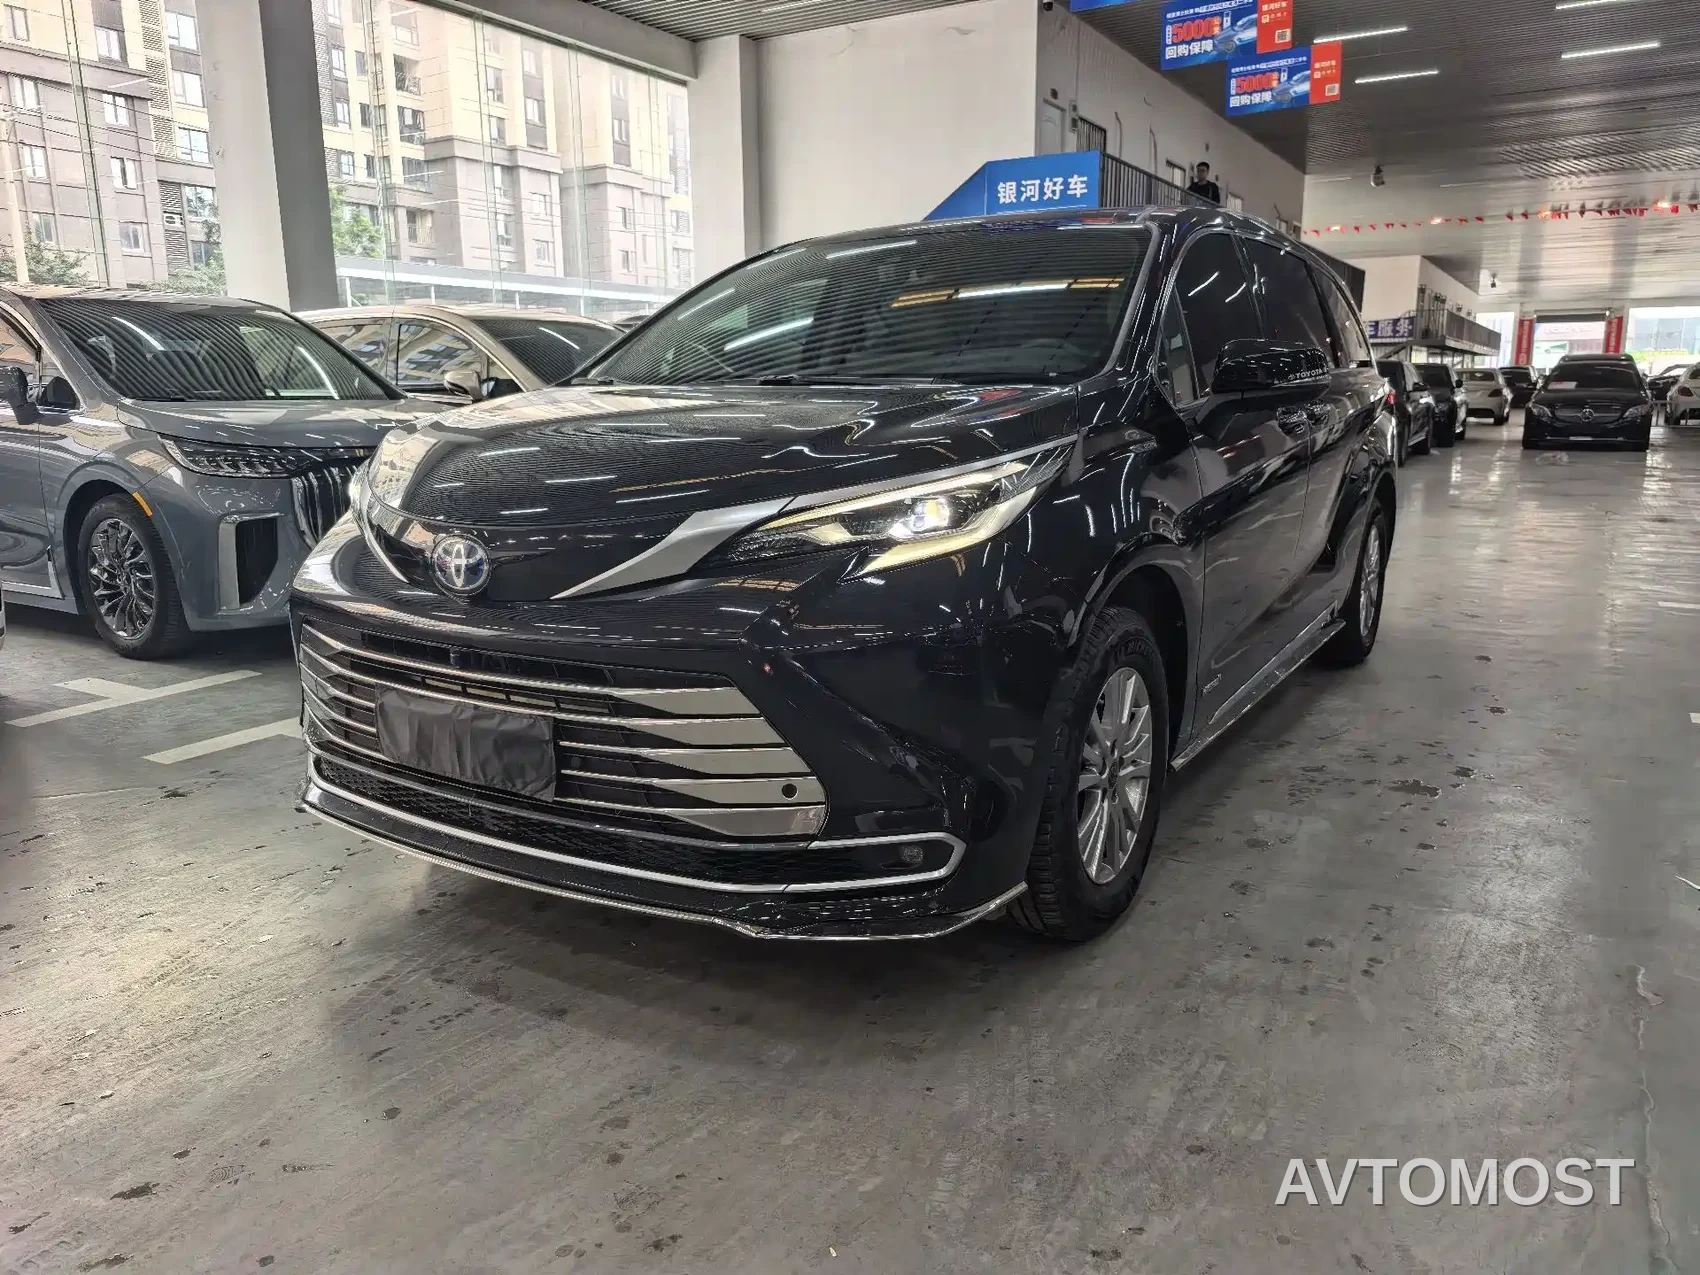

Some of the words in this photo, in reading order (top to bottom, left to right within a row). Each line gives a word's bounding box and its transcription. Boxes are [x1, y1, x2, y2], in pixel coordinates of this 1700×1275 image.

[1172, 18, 1214, 43] 5000
[1165, 39, 1213, 59] 回购保障
[1235, 73, 1273, 94] 5000
[1230, 91, 1272, 107] 回购保障
[997, 174, 1088, 204] 银河好车
[1295, 368, 1323, 379] TOYOTA
